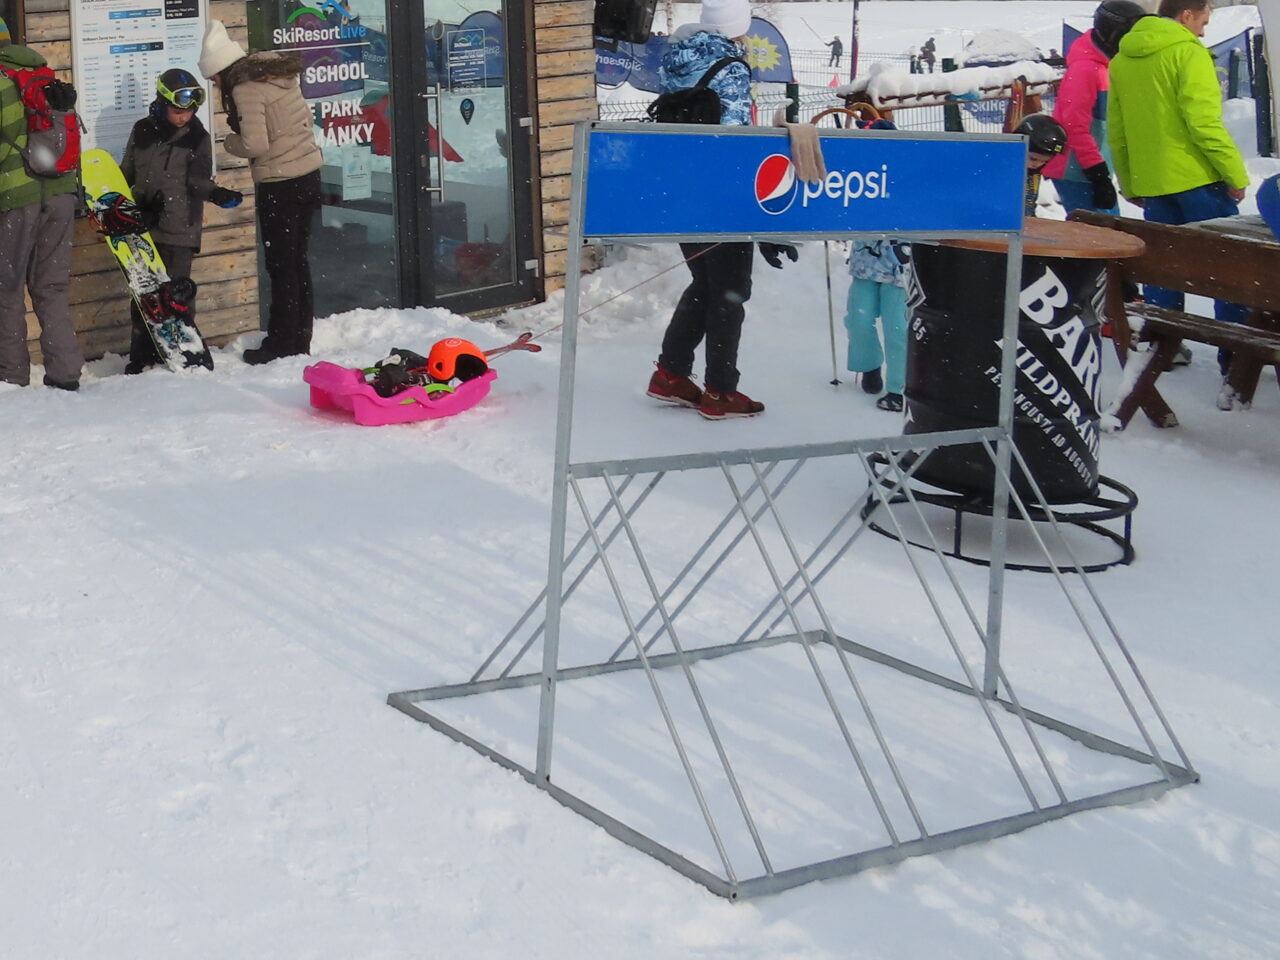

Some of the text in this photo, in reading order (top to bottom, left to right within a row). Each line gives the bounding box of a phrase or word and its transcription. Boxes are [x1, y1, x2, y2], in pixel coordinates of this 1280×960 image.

[273, 24, 367, 45] SkiResortLive
[306, 62, 370, 84] SCHOOL
[322, 98, 364, 119] PARK
[315, 122, 375, 147] MÁNKY
[802, 164, 888, 208] pepsi
